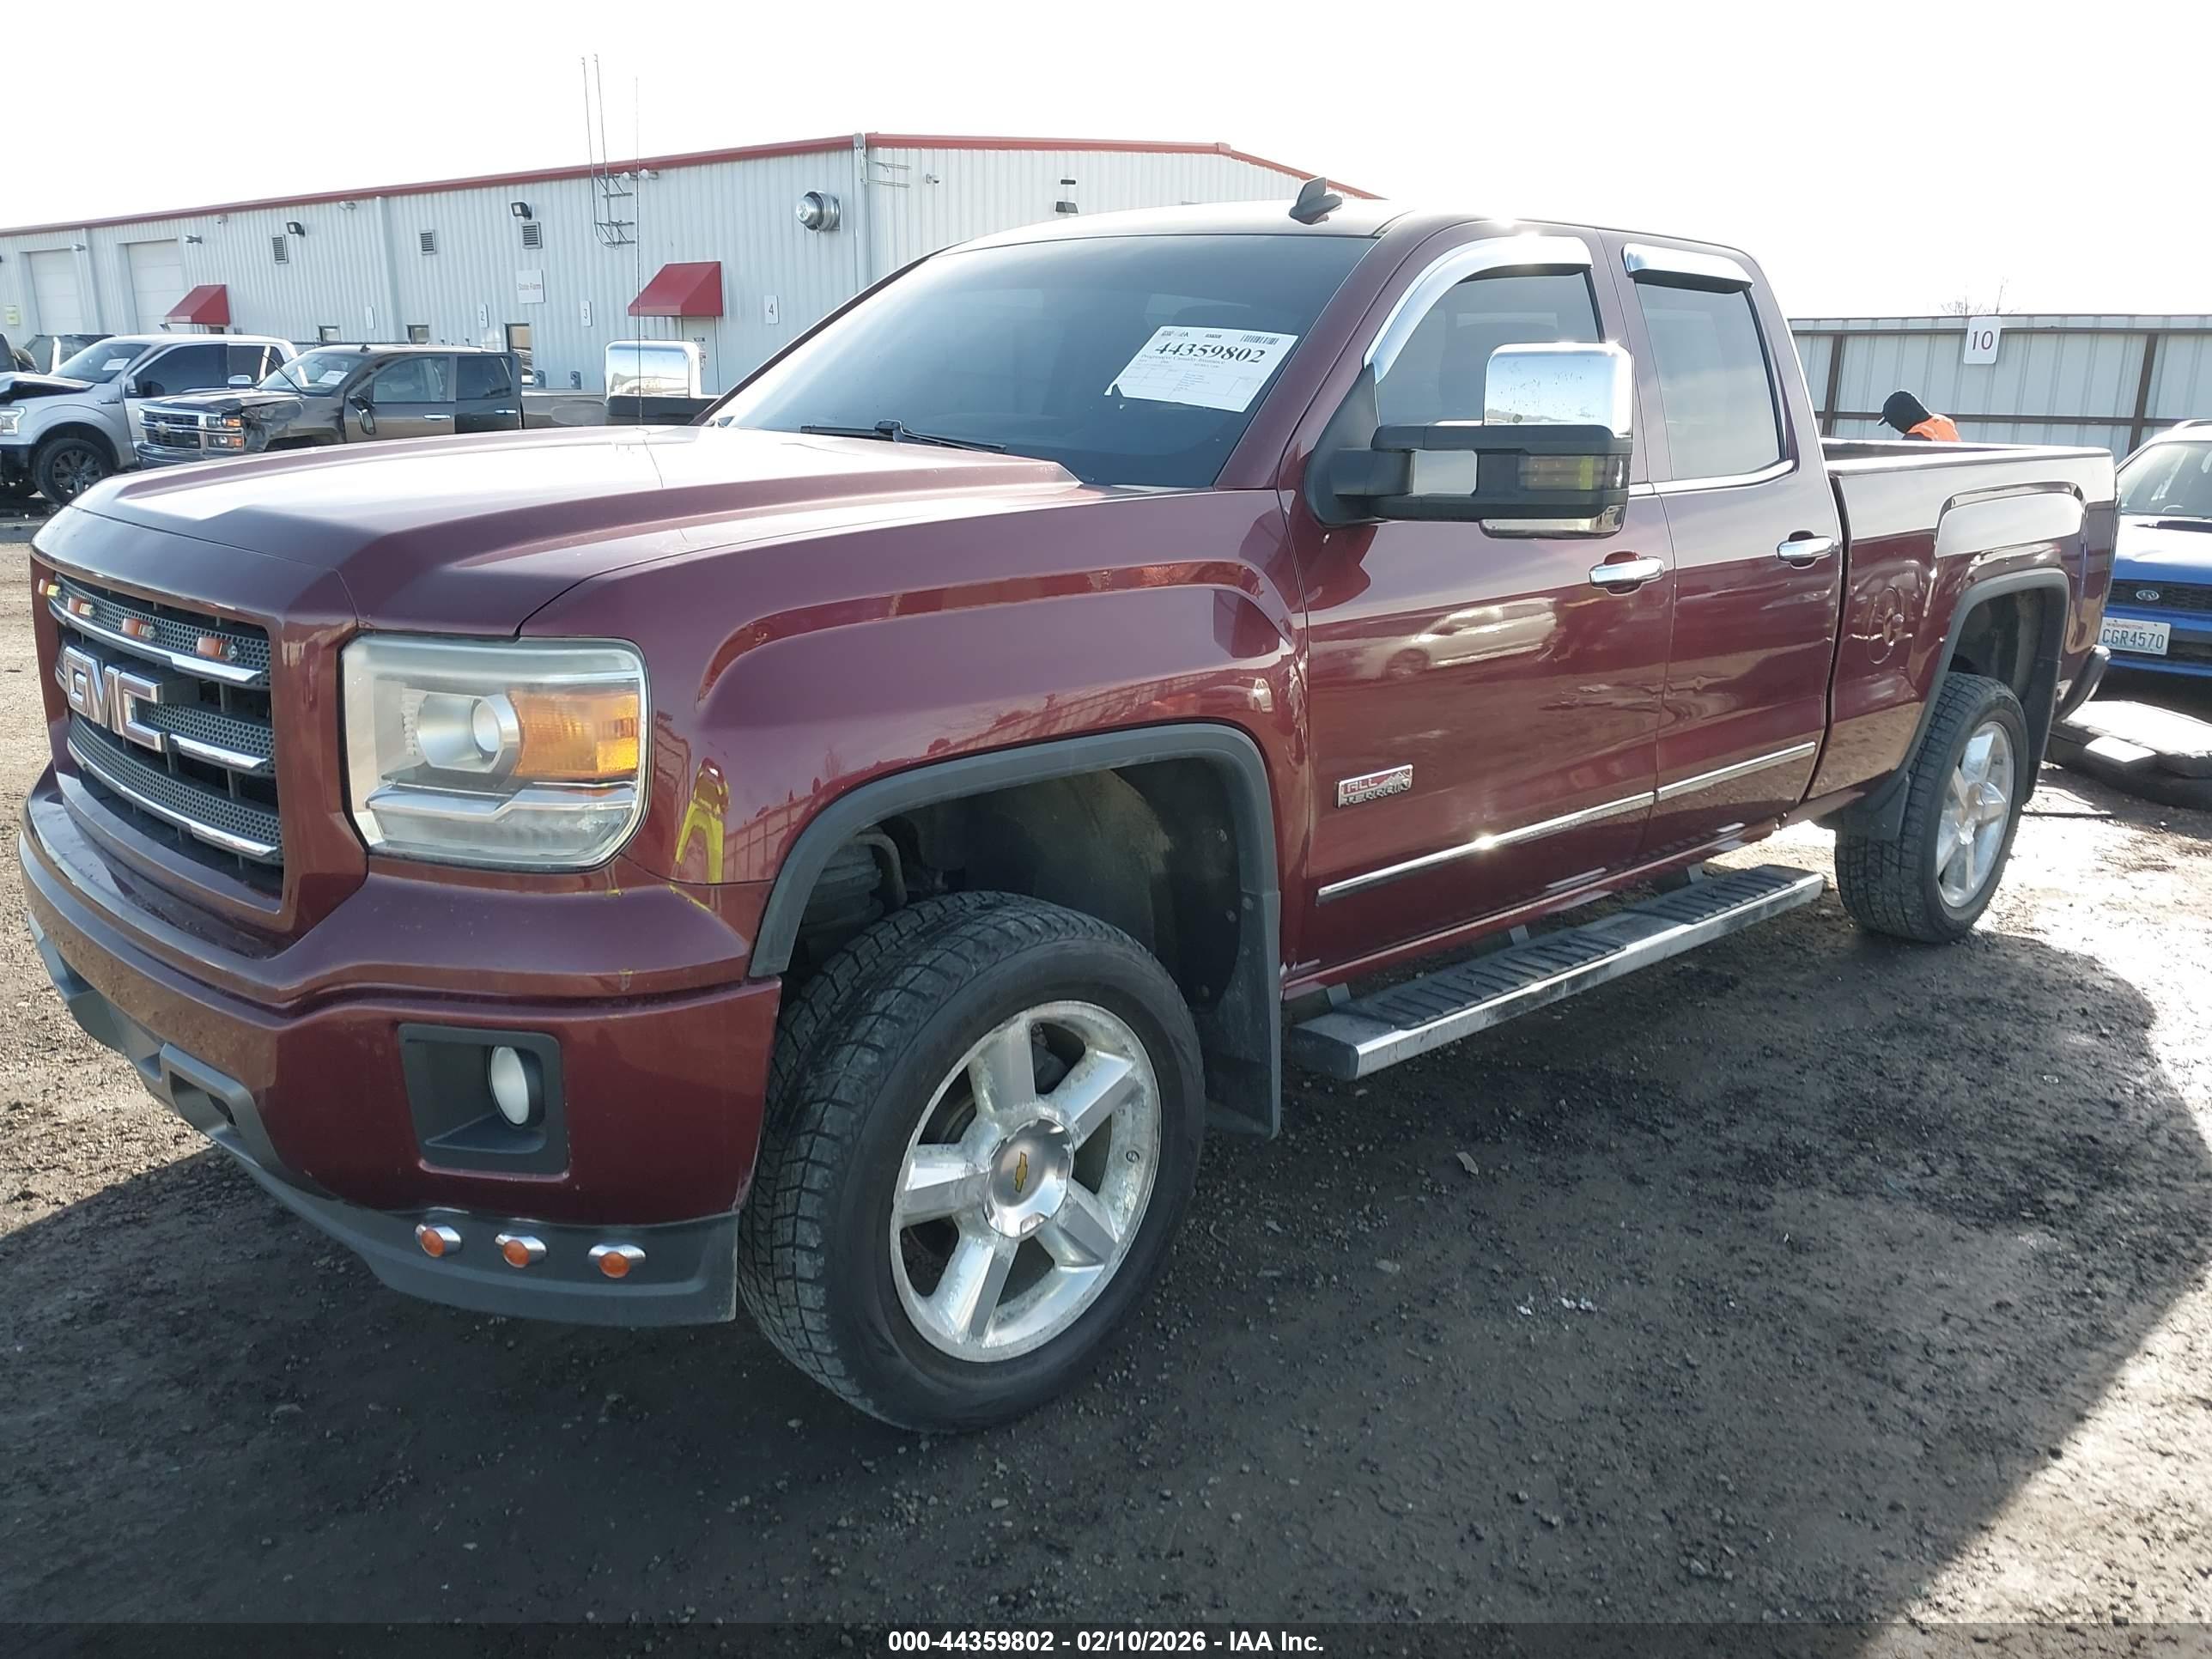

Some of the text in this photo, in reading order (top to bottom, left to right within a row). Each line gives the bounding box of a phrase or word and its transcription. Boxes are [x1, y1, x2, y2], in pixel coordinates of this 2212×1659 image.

[769, 303, 775, 316] 4
[1972, 331, 1994, 350] 10
[1155, 342, 1266, 363] 44359802
[2102, 629, 2165, 649] CGR4570
[63, 646, 165, 752] GMC
[1346, 779, 1378, 793] ALL
